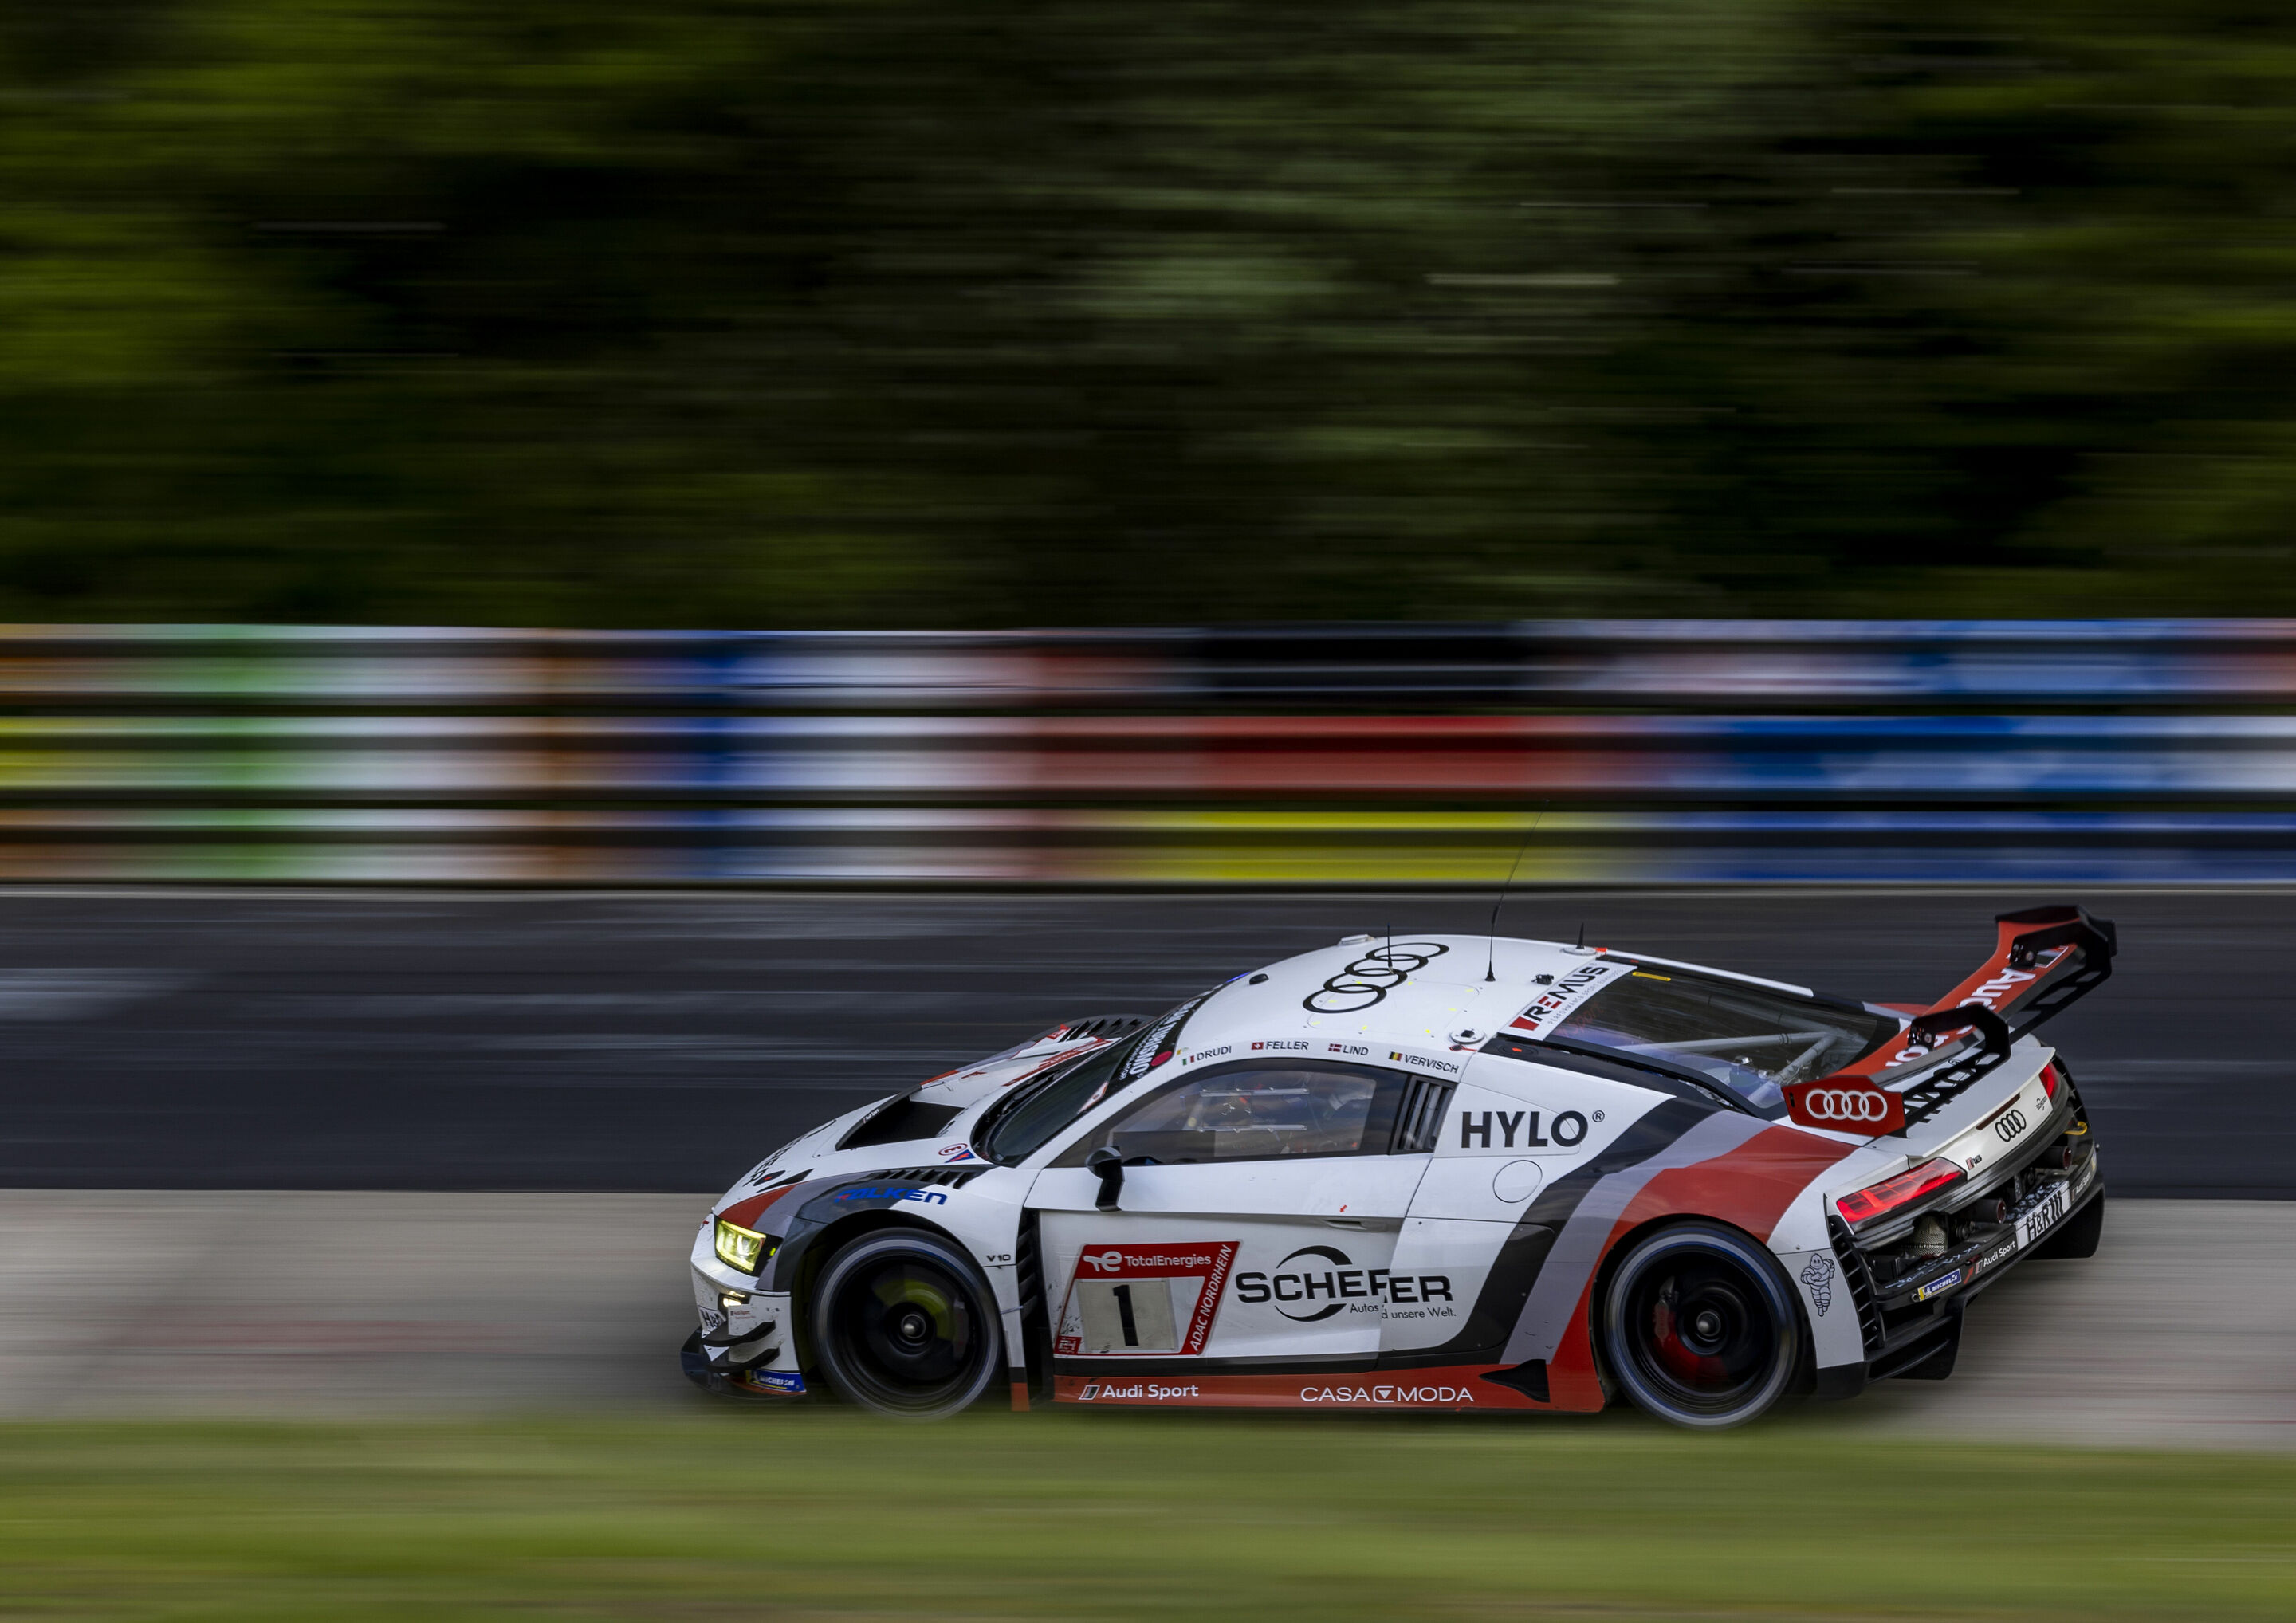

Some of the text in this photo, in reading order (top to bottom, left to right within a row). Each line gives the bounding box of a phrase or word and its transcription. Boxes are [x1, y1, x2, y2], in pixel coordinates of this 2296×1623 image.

[1523, 966, 1610, 1022] REMUS
[1955, 967, 2037, 1012] Au
[1197, 1045, 1232, 1061] DRUDI
[1266, 1041, 1309, 1051] FELLER
[1343, 1044, 1369, 1056] LIND
[1405, 1054, 1460, 1075] VERVISCH
[835, 1186, 948, 1206] FALKEN
[1125, 1253, 1212, 1268] TotalEnergies
[1983, 1240, 2017, 1268] Audi Sport
[1189, 1244, 1233, 1351] ADAC NORDRHEIN
[1112, 1284, 1139, 1347] 1
[1350, 1302, 1379, 1314] Autos
[1391, 1310, 1425, 1319] unsere
[1426, 1306, 1457, 1318] Welt.
[1102, 1384, 1199, 1400] Audi Sport
[1300, 1386, 1475, 1402] CASA MODA
